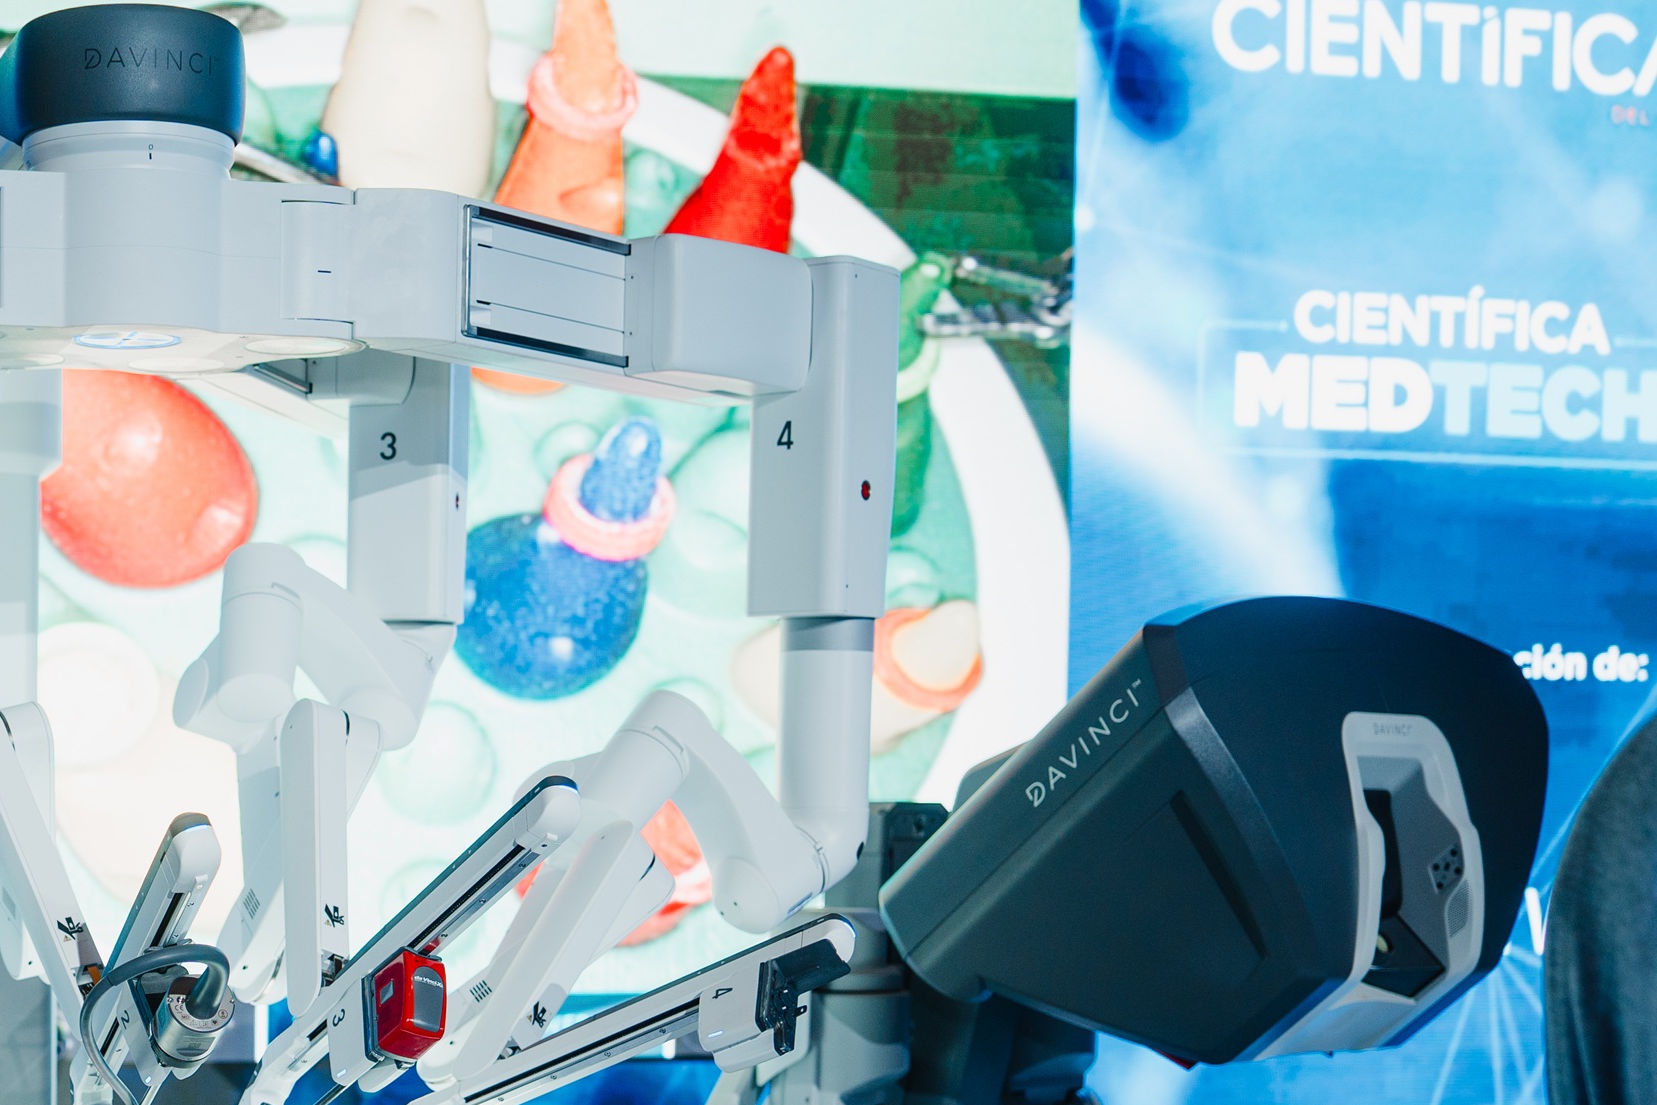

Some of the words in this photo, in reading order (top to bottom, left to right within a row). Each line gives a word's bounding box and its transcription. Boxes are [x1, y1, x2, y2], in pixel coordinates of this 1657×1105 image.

[84, 47, 212, 76] DAVINCI
[1294, 285, 1611, 355] CIENTÍFICA
[1233, 351, 1657, 443] MEDTECH
[380, 432, 397, 460] 3
[776, 420, 794, 450] 4
